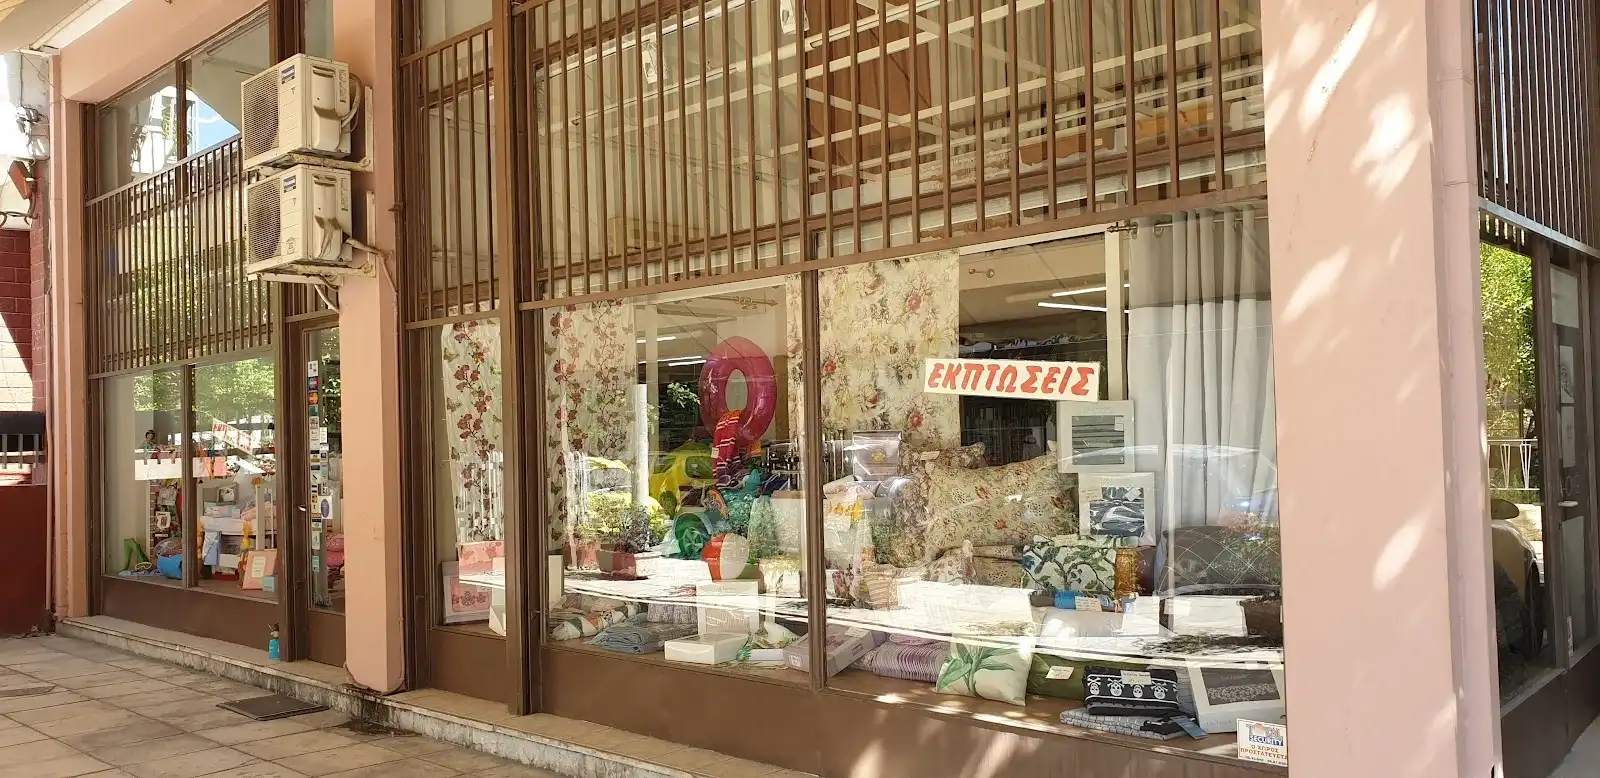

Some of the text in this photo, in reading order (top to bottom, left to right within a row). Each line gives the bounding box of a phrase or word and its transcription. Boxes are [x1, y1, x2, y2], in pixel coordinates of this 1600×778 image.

[927, 362, 1095, 396] ΕΚΠΤΩΣΕΙΣ
[1249, 735, 1283, 746] SECURITY
[1257, 745, 1279, 753] ΧΩΡΟΣ
